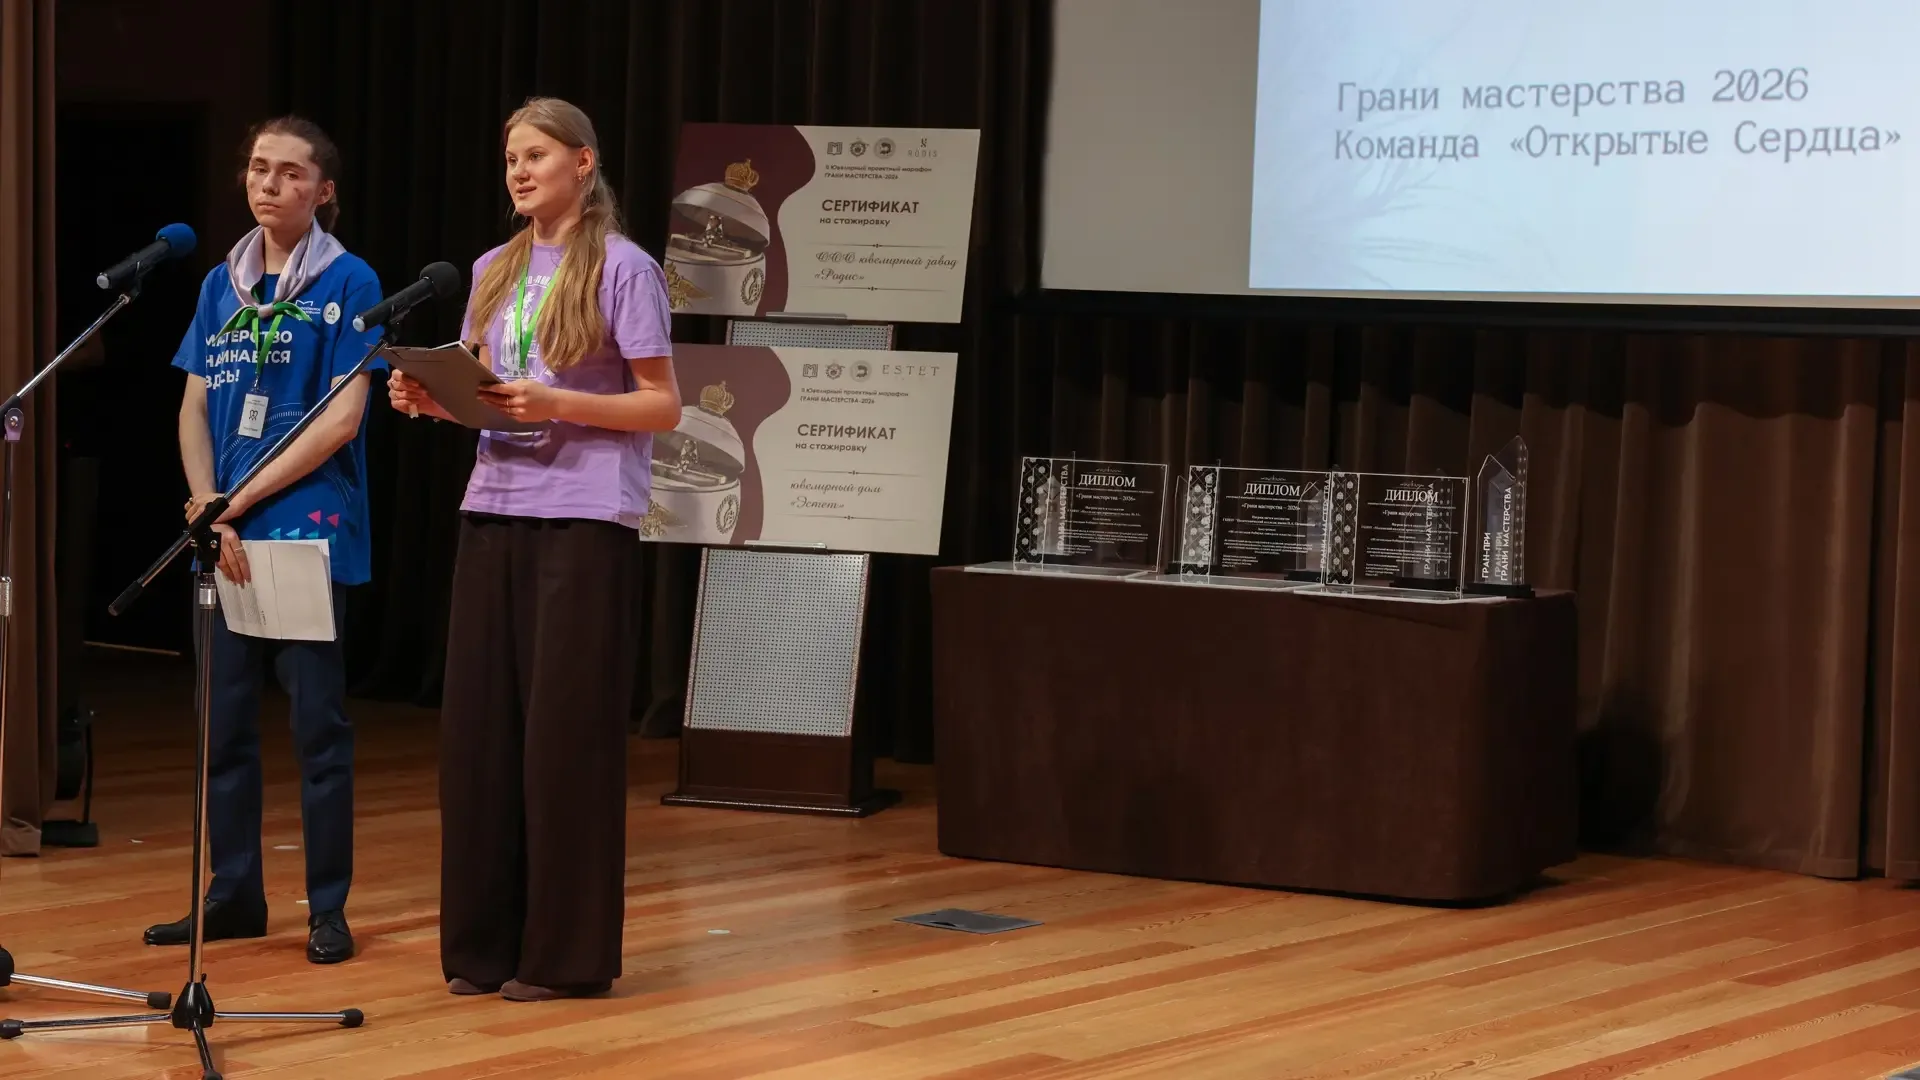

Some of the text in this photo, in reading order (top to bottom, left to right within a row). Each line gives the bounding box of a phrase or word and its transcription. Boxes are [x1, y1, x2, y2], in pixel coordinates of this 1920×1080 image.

[1337, 67, 1810, 121] Грани мастерства 2026
[1334, 119, 1902, 167] Команда «Открытые Сердца»
[821, 199, 920, 214] СЕРТИФИКАТ
[834, 217, 891, 227] стажировку
[858, 252, 923, 269] ювелирный
[924, 254, 957, 270] завод
[814, 267, 865, 284] «Родис»
[882, 363, 940, 377] ESTET
[205, 368, 240, 390] ЗДСЬ!
[797, 423, 897, 440] СЕРТИФИКАТ
[809, 443, 868, 454] стажировку
[790, 477, 882, 497] ювелирный дом
[1078, 473, 1137, 488] ДИПЛОМ
[1243, 482, 1301, 497] ДИПЛОМ
[1384, 488, 1439, 503] ДИПЛОМ
[790, 495, 845, 509] «Эстет»
[1500, 487, 1512, 581] ГРАНИ МАСТЕРСТВА
[1423, 544, 1432, 575] ГРАНИ
[1481, 532, 1492, 579] ГРАН-ПРИ
